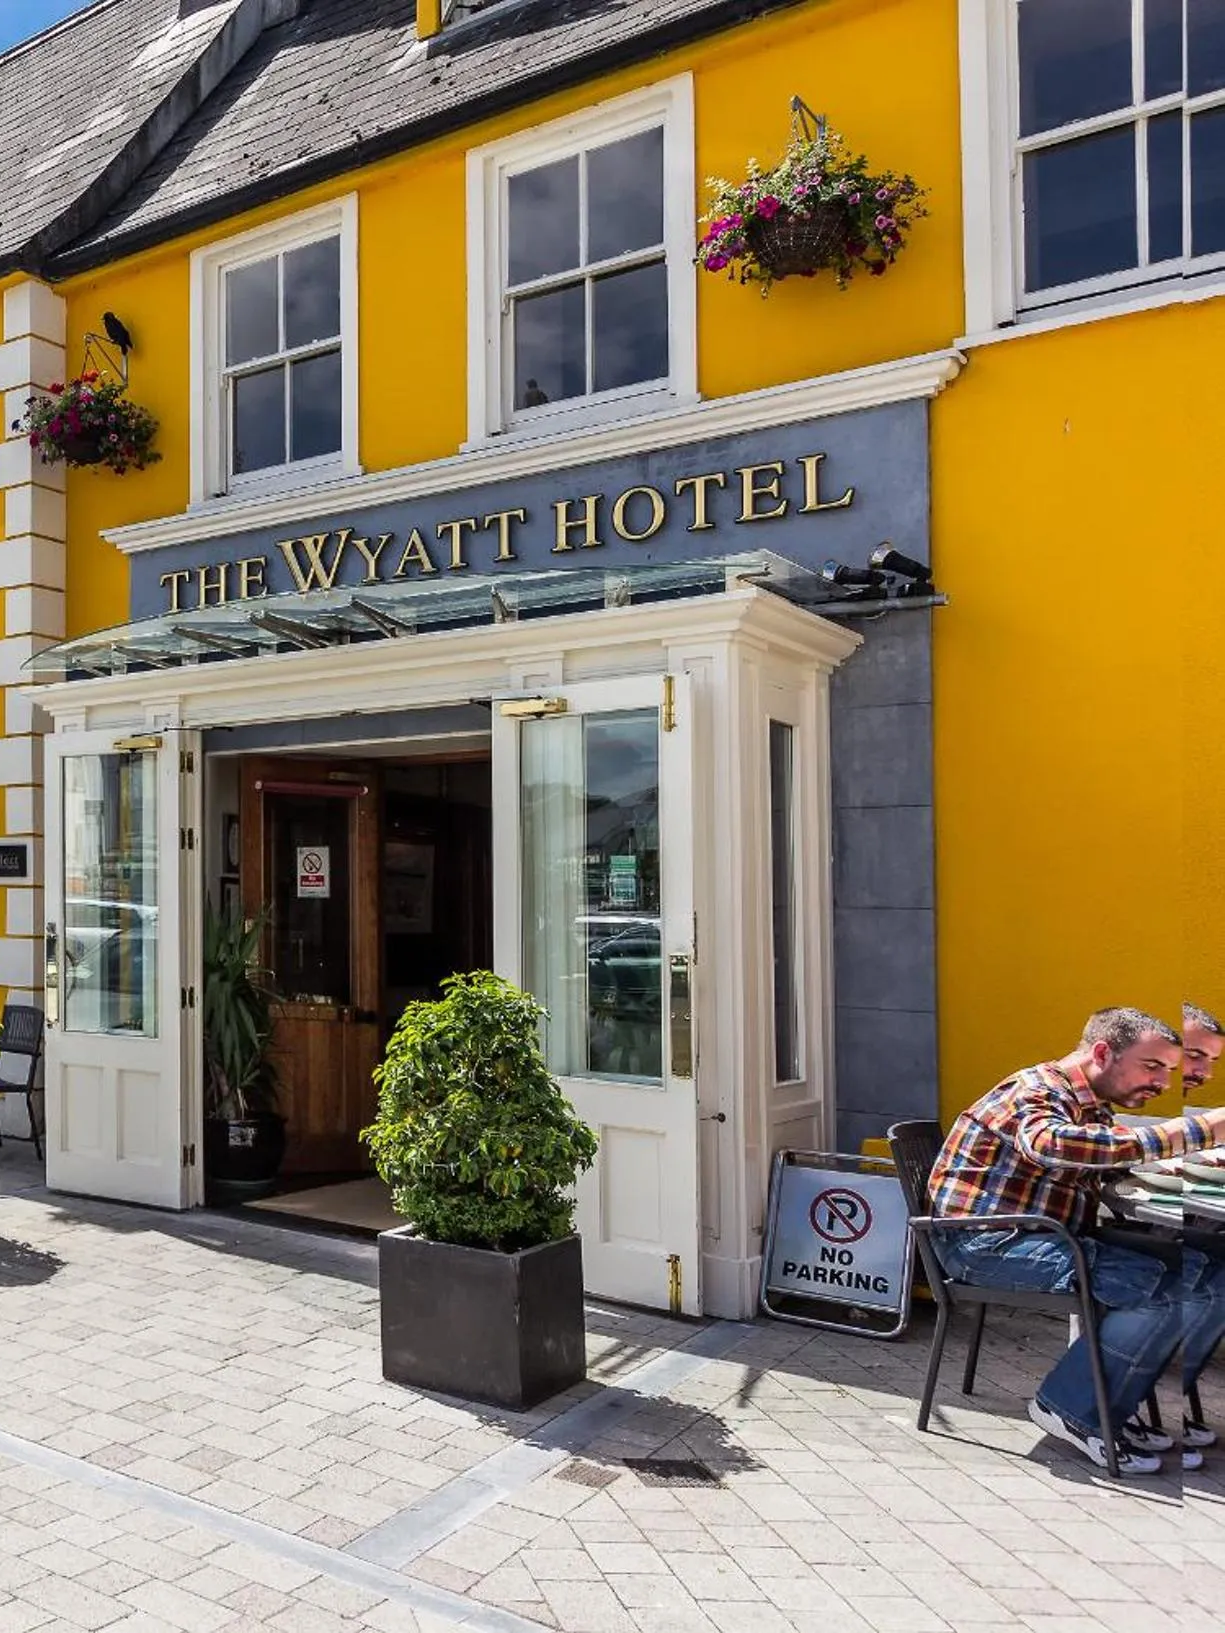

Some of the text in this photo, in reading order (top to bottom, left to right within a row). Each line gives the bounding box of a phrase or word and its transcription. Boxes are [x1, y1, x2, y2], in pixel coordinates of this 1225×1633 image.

[159, 452, 856, 614] THE WYATT HOTEL
[820, 1246, 854, 1266] NO
[782, 1260, 889, 1294] PARKING
